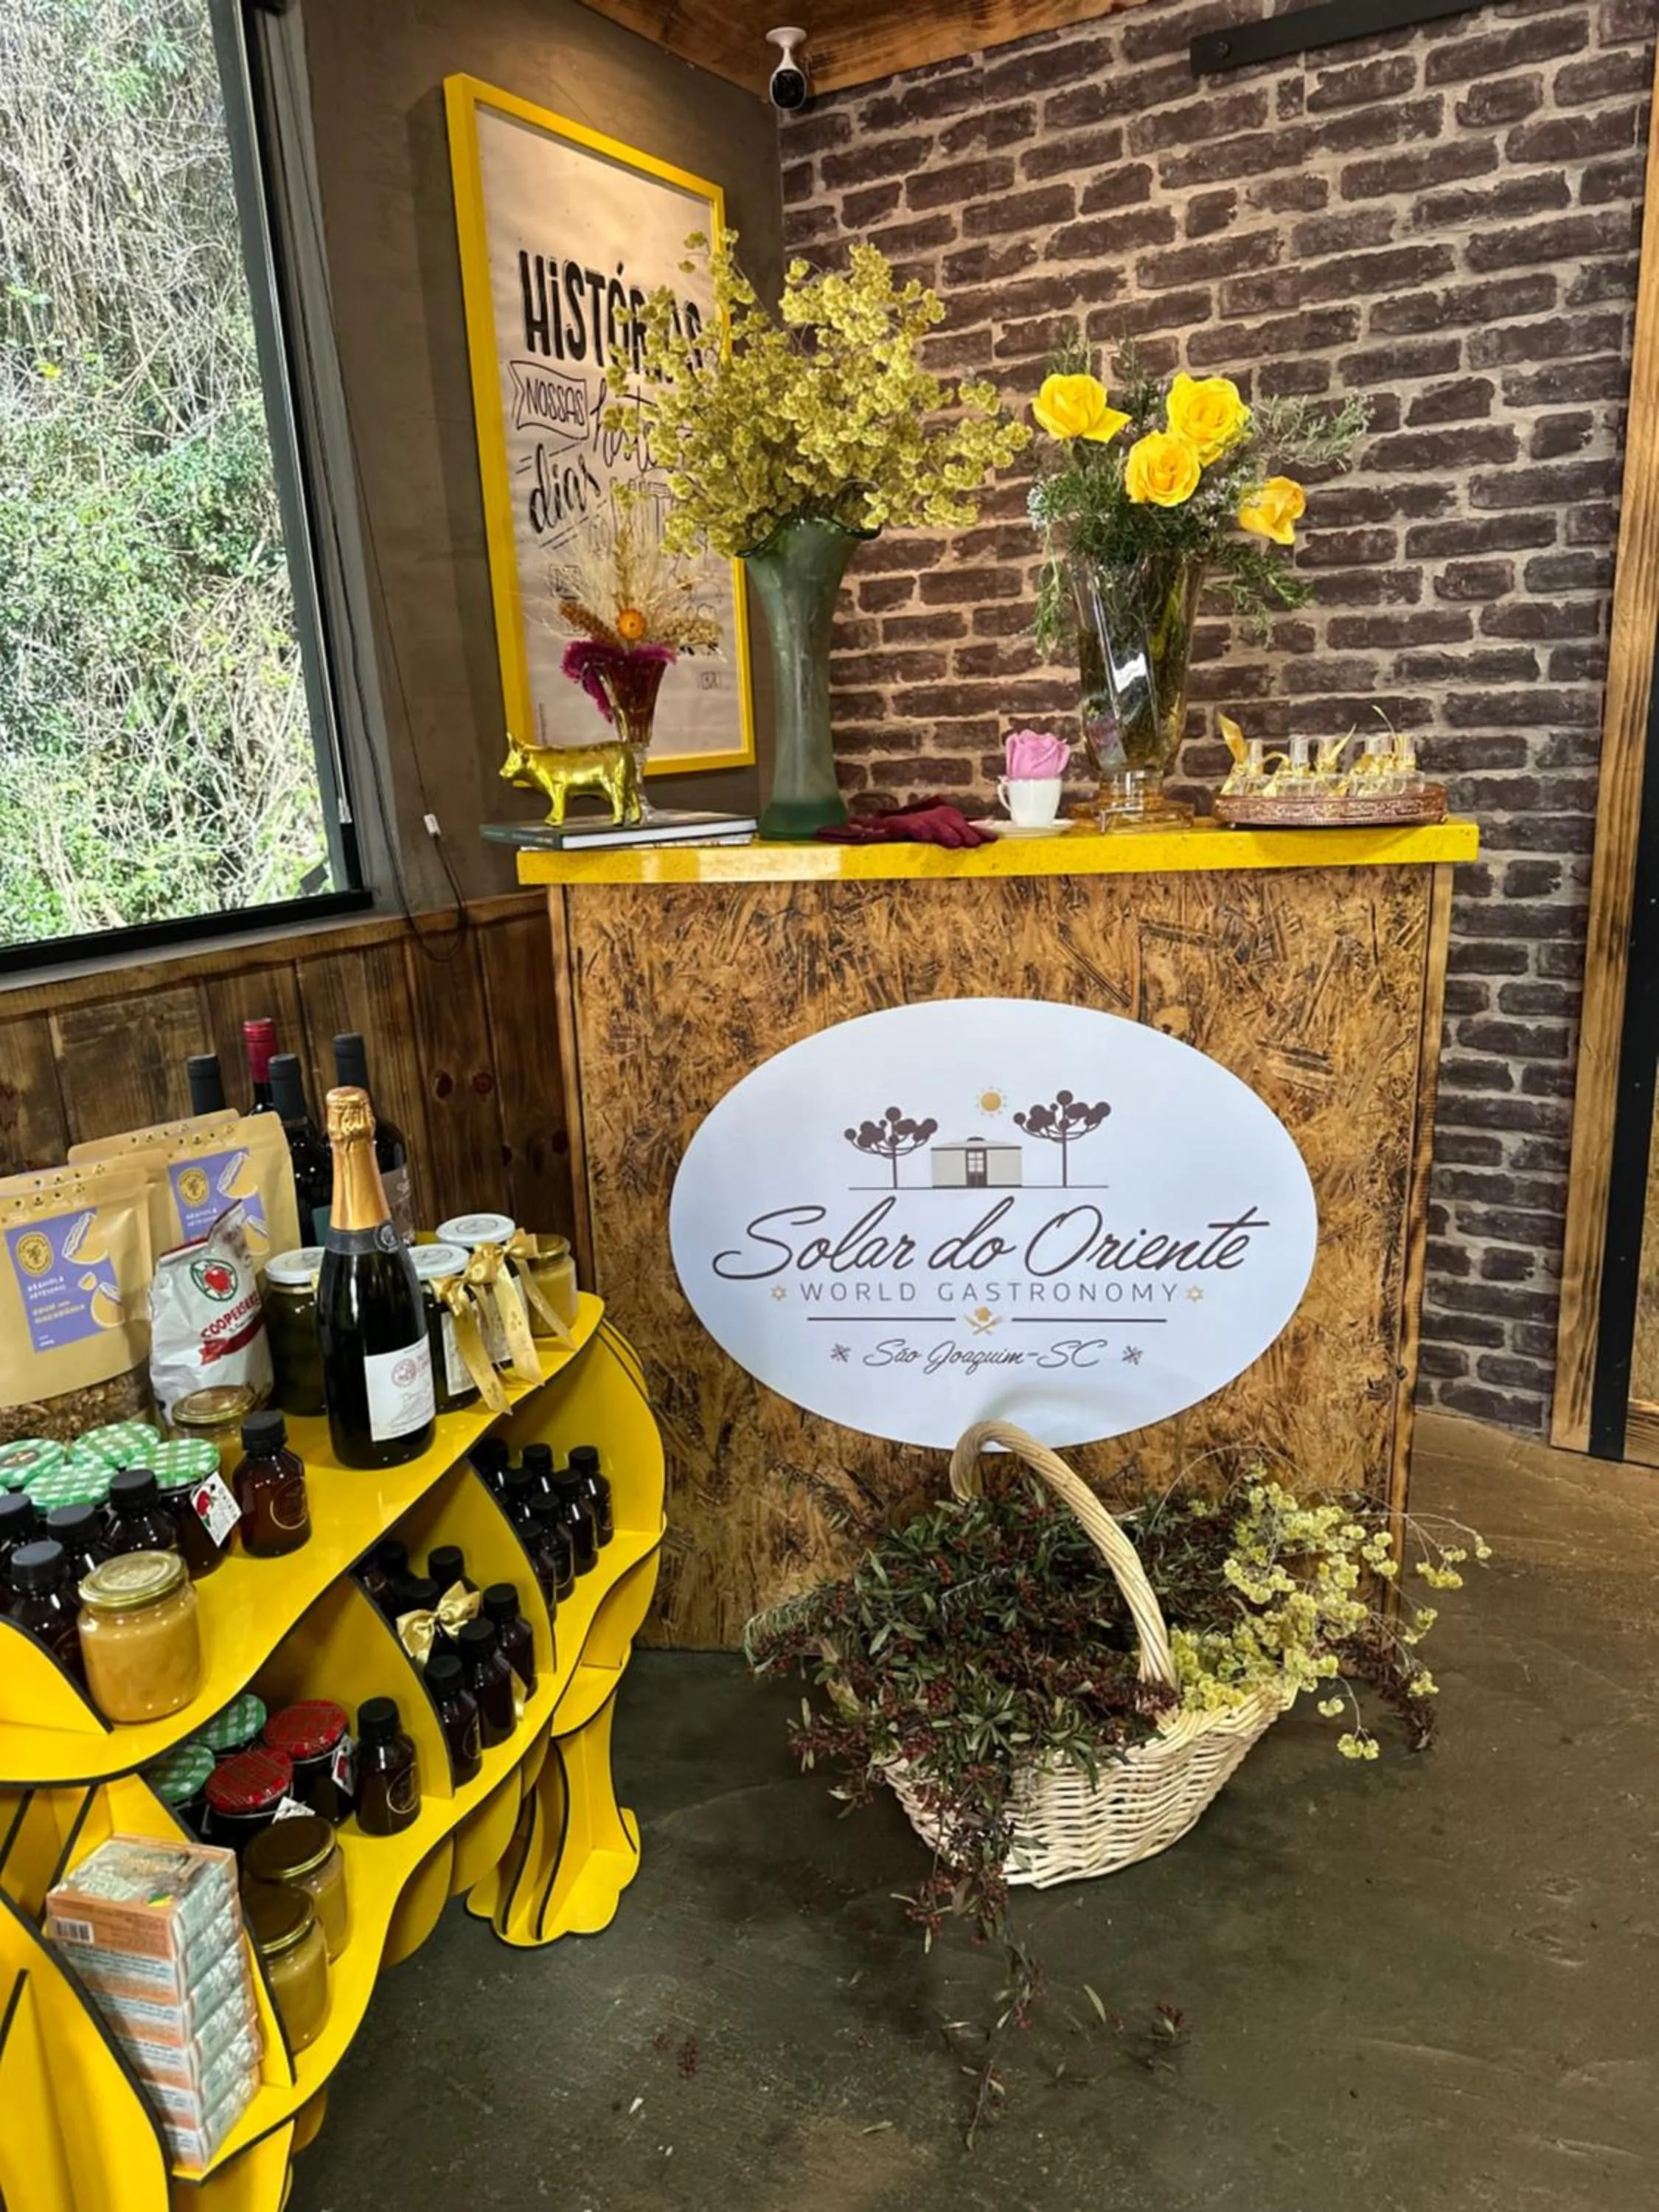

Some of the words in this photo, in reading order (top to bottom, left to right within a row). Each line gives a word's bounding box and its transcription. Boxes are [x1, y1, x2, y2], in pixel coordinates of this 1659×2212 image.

[526, 377, 585, 426] NOSSAS
[529, 442, 601, 534] dias
[712, 1196, 916, 1280] Solar
[928, 1196, 1017, 1270] do
[1024, 1204, 1270, 1277] Oriente
[800, 1283, 917, 1302] WORLD
[938, 1283, 1178, 1303] GASTRONOMY
[863, 1338, 921, 1366] São
